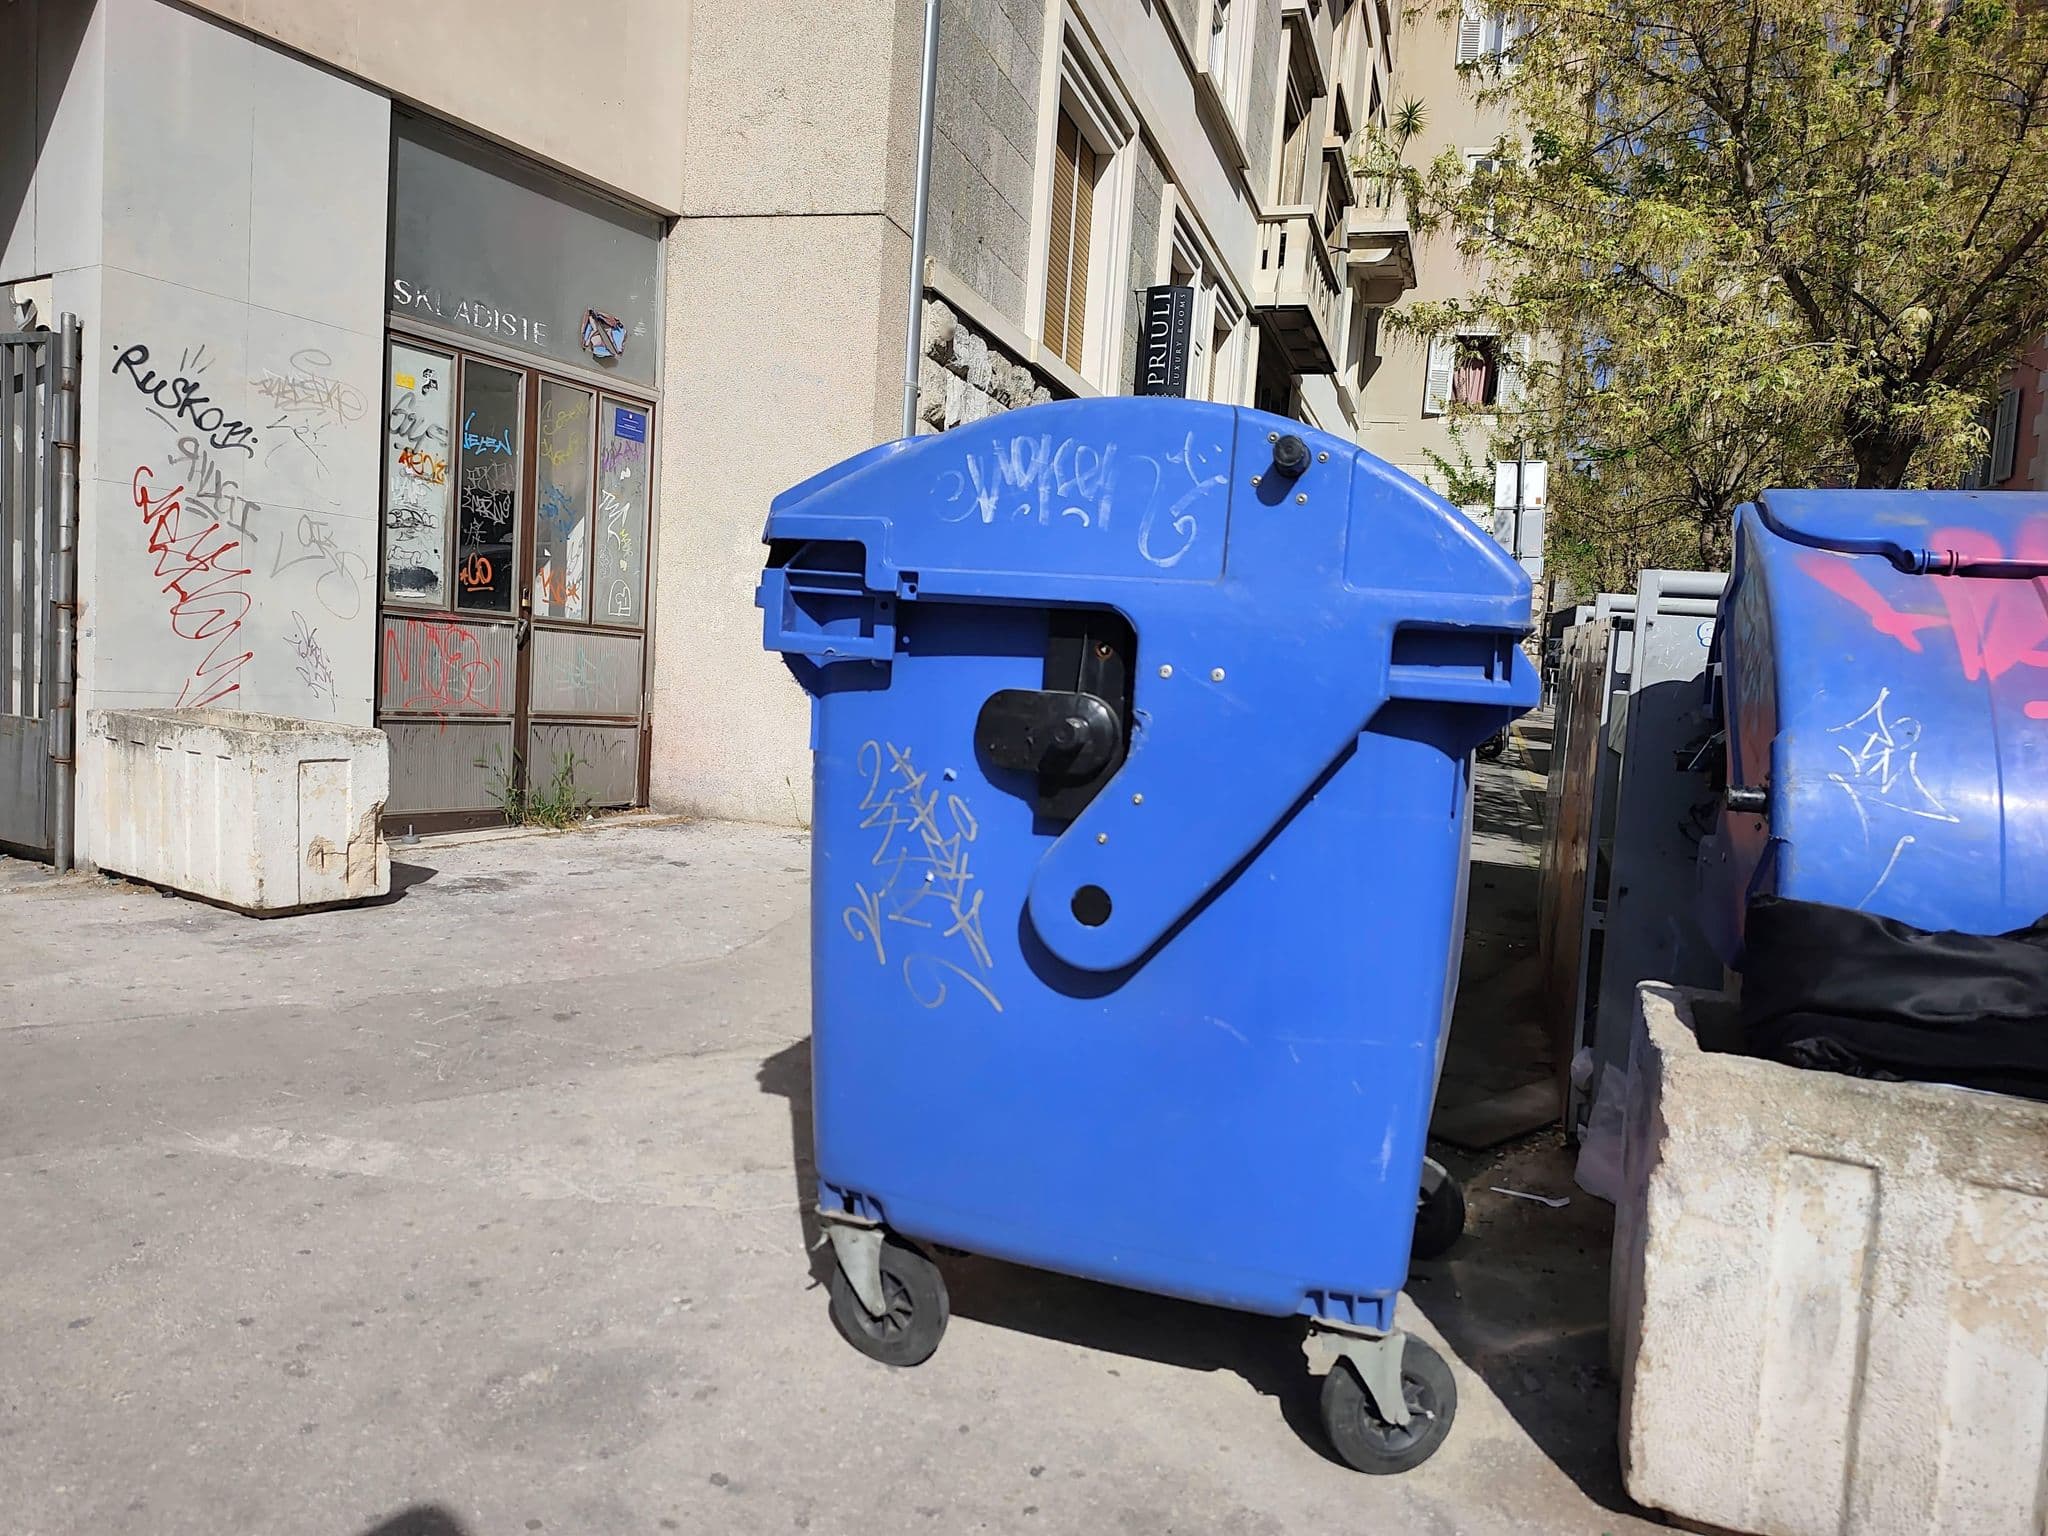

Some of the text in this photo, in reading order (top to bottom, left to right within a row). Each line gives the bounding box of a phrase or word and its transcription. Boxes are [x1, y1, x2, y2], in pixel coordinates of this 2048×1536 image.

[1147, 292, 1172, 386] PRIULI
[1173, 294, 1186, 386] LUXURY ROOMS
